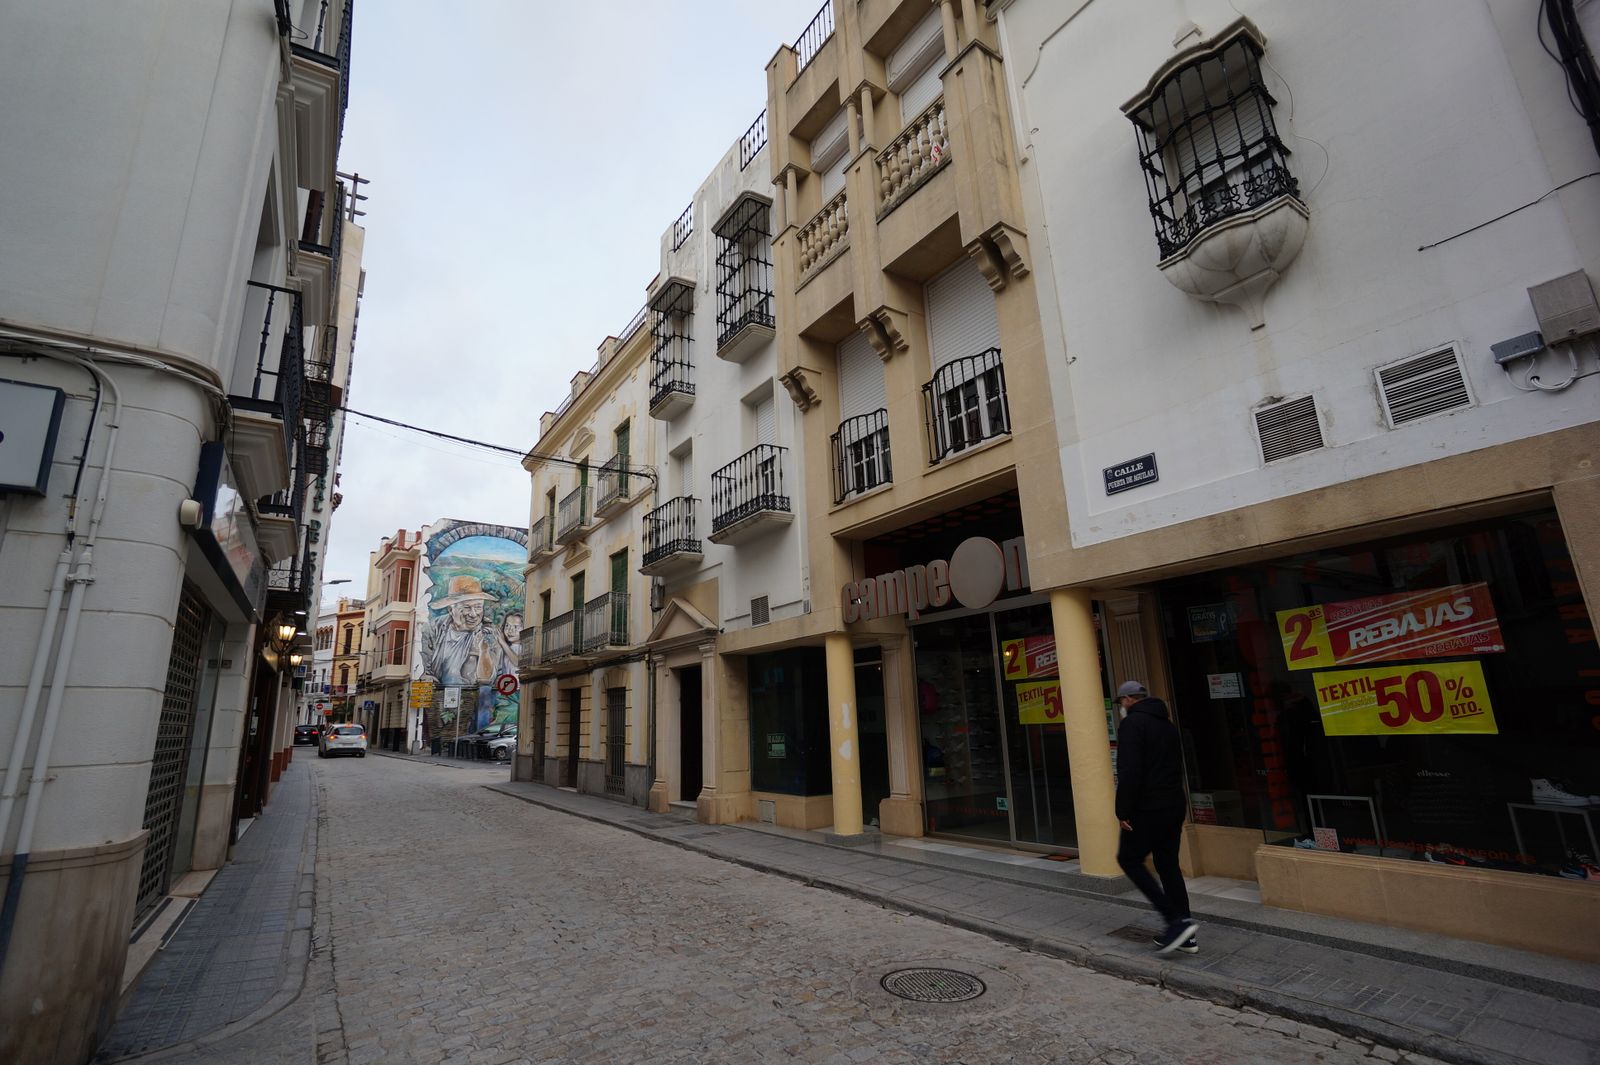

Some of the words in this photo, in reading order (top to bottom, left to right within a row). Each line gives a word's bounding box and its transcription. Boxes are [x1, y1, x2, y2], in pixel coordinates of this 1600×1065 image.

[1107, 478, 1126, 489] PUERTA
[1125, 475, 1133, 484] DE
[1133, 469, 1155, 482] AGUILAR
[1114, 462, 1144, 477] CALLE
[1348, 596, 1474, 651] REBAJAS
[1425, 629, 1489, 656] REBAJAS
[1018, 686, 1045, 703] TEXTIL
[1319, 676, 1377, 703] TEXTIL
[1450, 701, 1483, 717] DTO.
